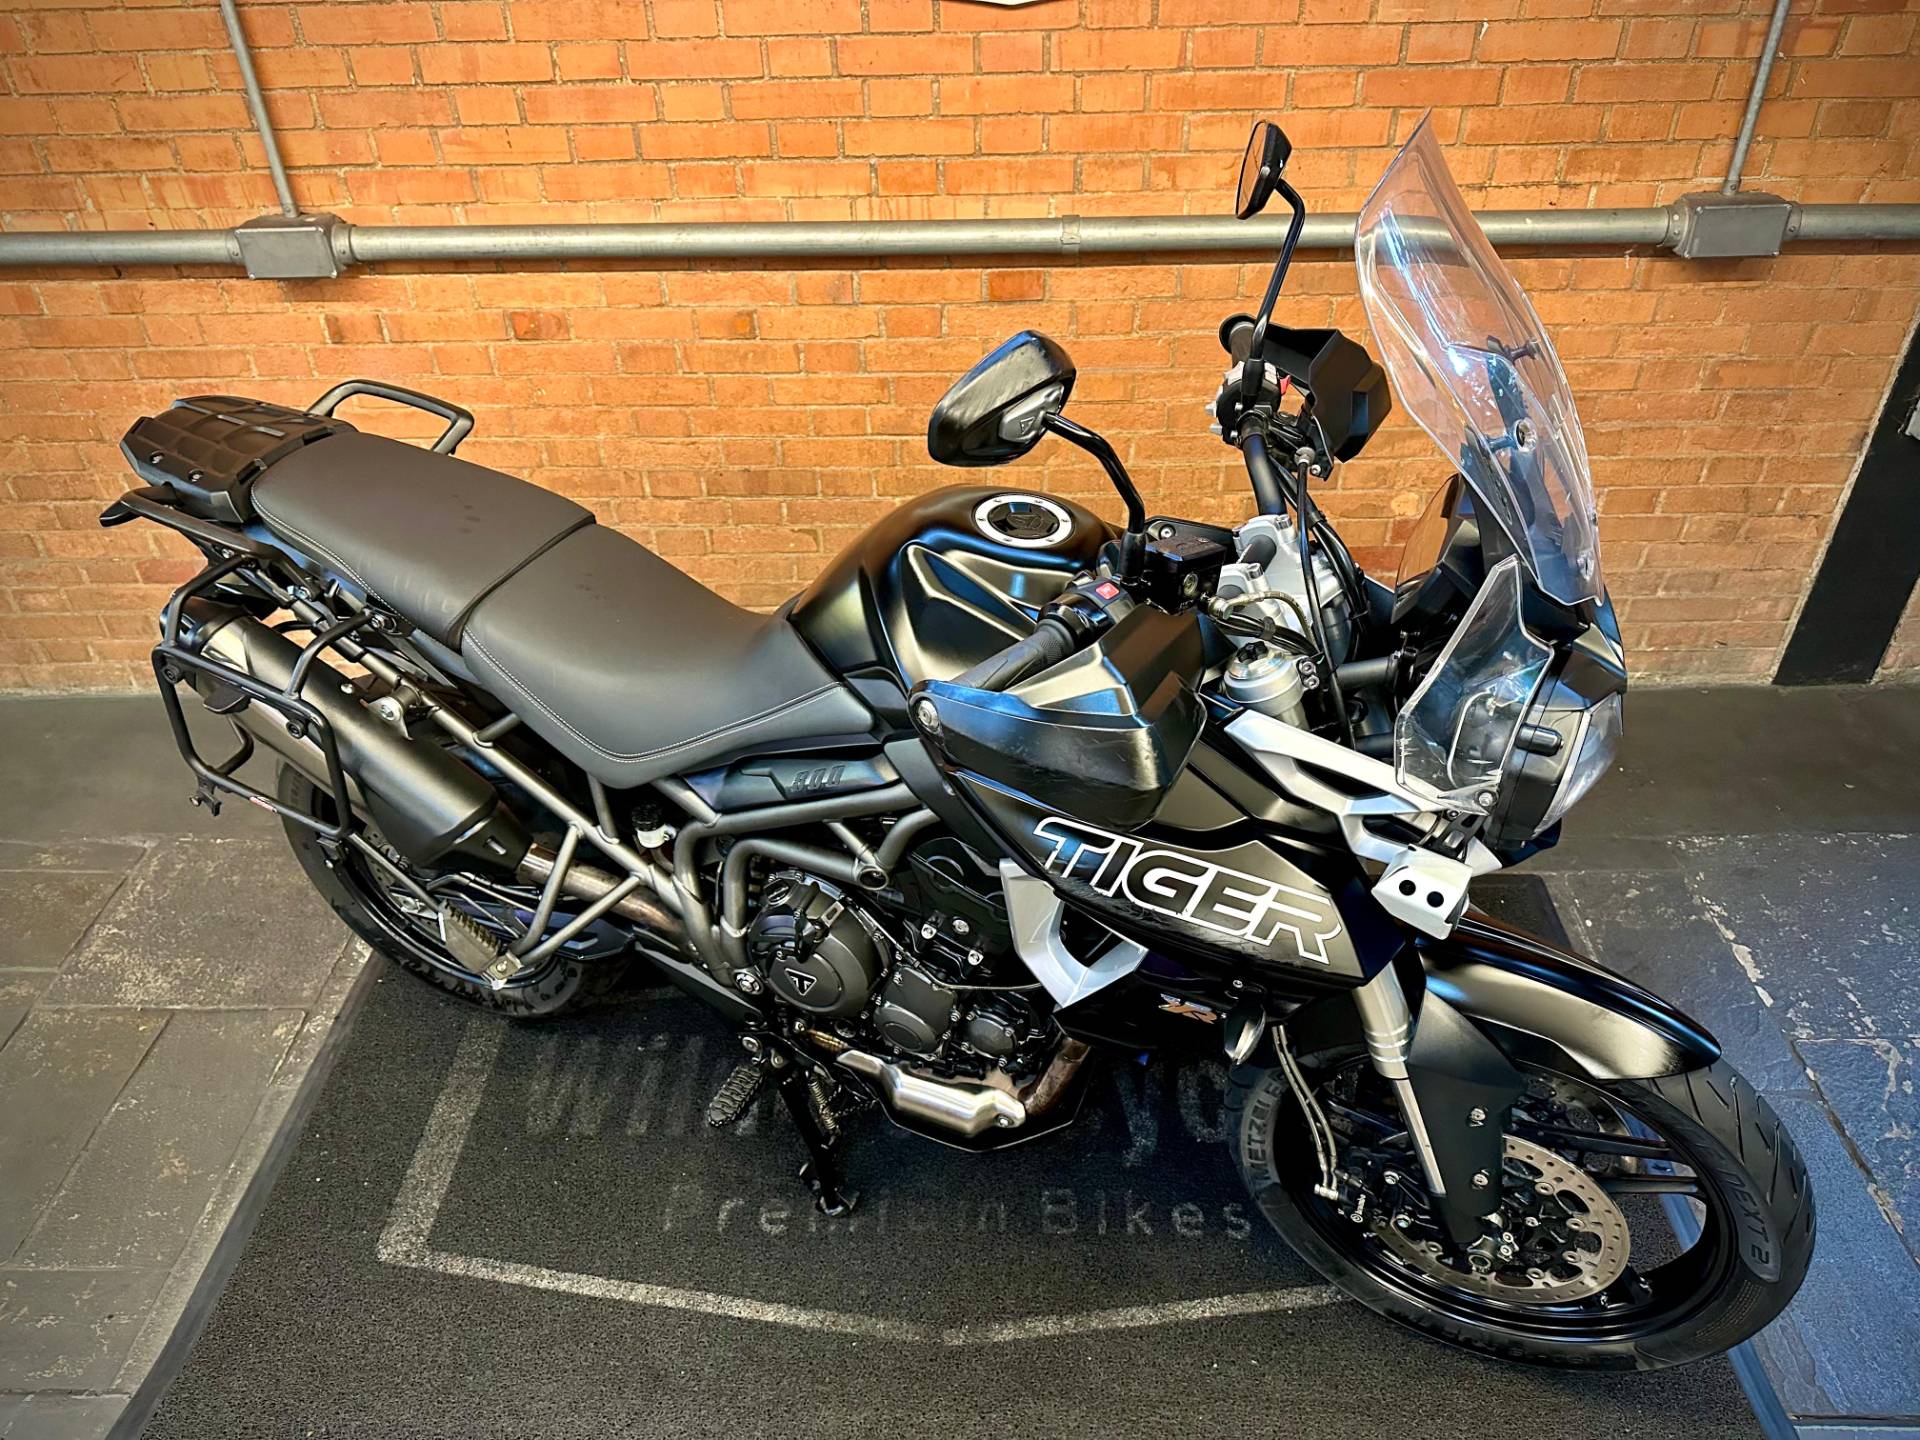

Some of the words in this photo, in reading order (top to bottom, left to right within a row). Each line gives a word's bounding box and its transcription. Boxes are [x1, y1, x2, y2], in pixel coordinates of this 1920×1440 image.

[1033, 816, 1343, 966] TIGER
[1040, 1187, 1253, 1240] Bikes
[1712, 1167, 1769, 1243] NEXT
[1751, 1244, 1769, 1265] 2
